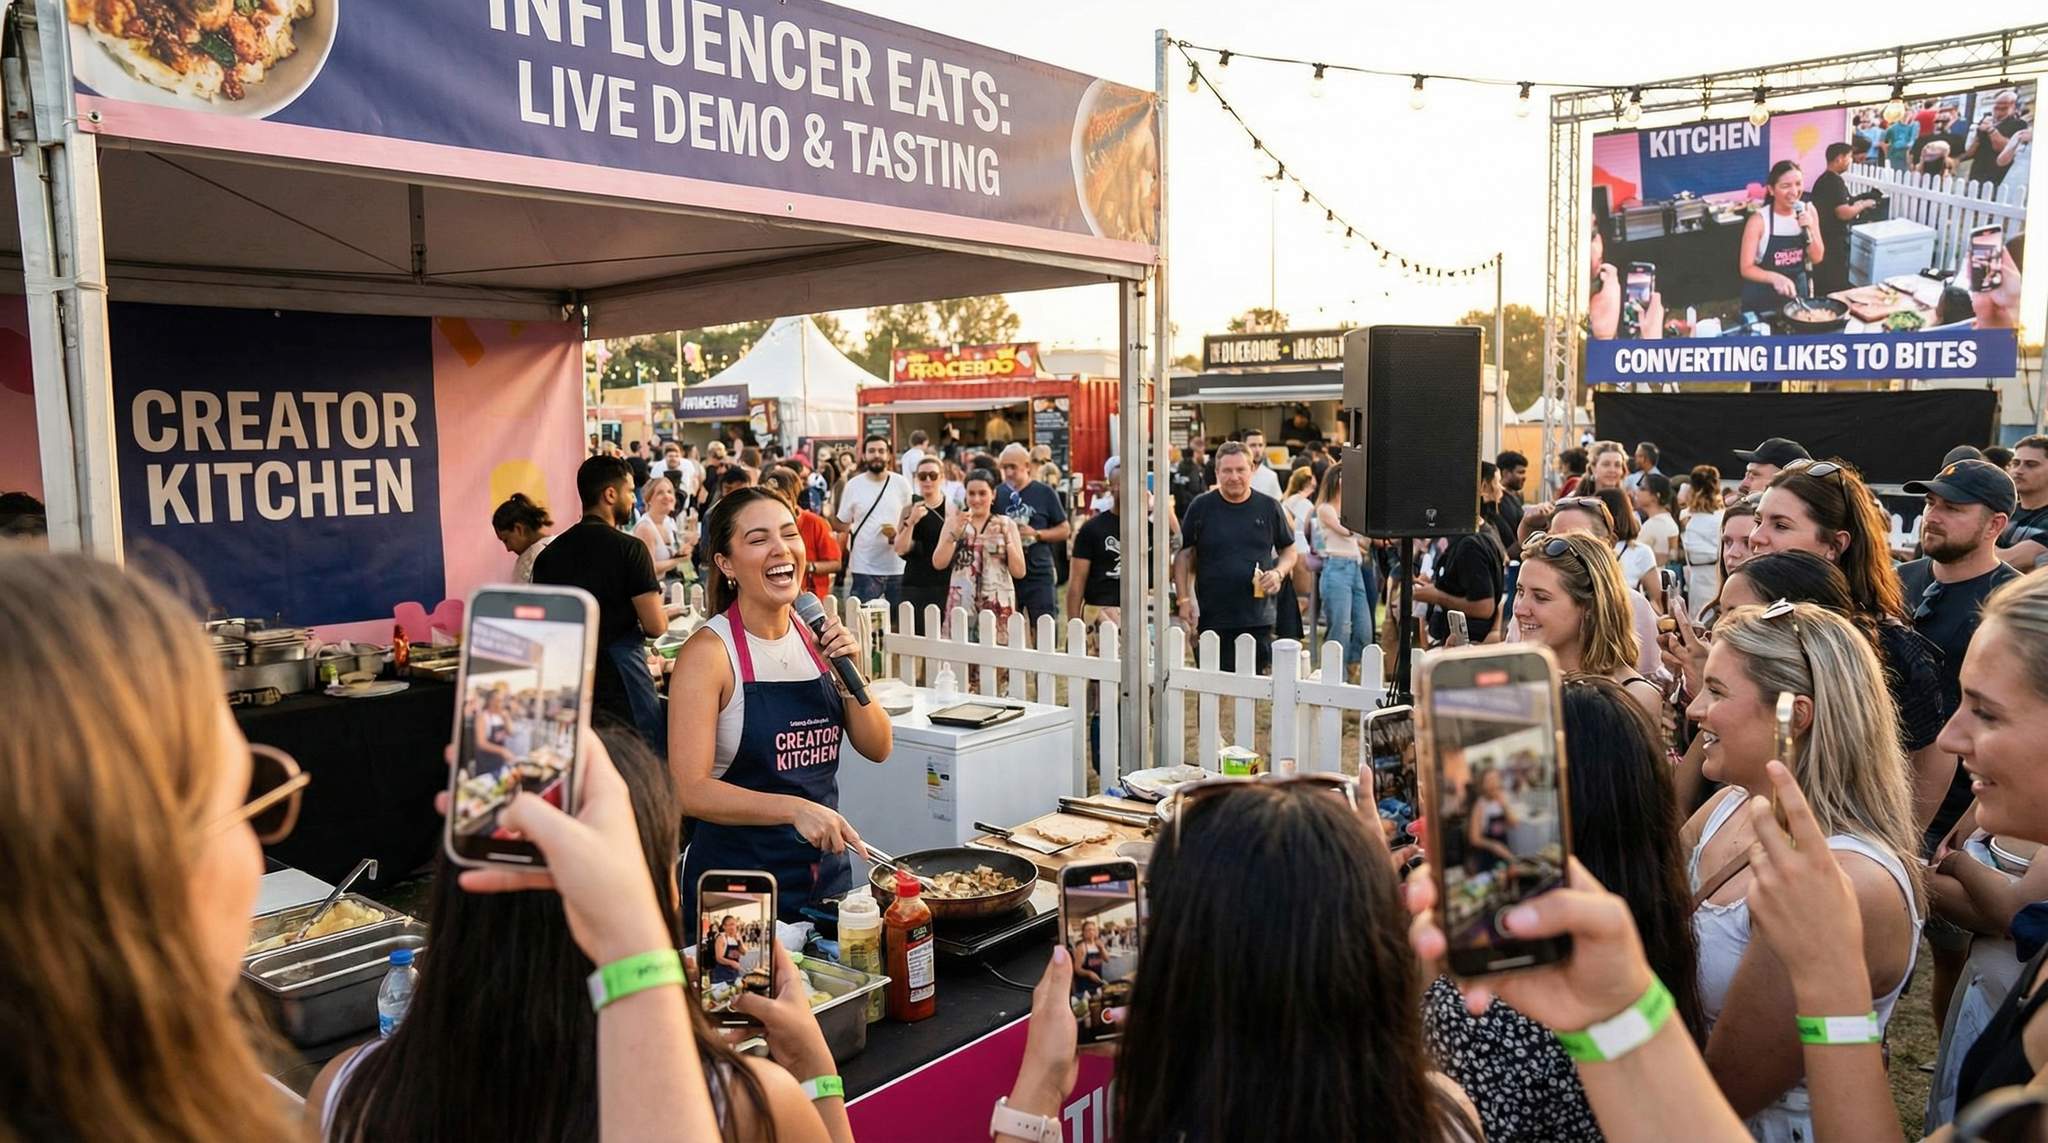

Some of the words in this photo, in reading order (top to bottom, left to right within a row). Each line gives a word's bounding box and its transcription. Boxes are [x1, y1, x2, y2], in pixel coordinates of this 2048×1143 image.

[887, 48, 1011, 136] EATS:
[518, 59, 638, 139] LIVE
[652, 84, 790, 162] DEMO
[803, 113, 834, 169] &
[843, 121, 1000, 197] TASTING
[1650, 121, 1760, 158] KITCHEN
[1615, 345, 1767, 373] CONVERTING
[1774, 344, 1847, 371] LIKES
[1853, 343, 1889, 370] TO
[1895, 340, 1977, 369] BITES
[131, 389, 419, 453] CREATOR
[146, 458, 413, 526] KITCHEN
[775, 725, 840, 751] CREATOR
[776, 744, 838, 771] KITCHEN
[1064, 1079, 1117, 1143] TI
